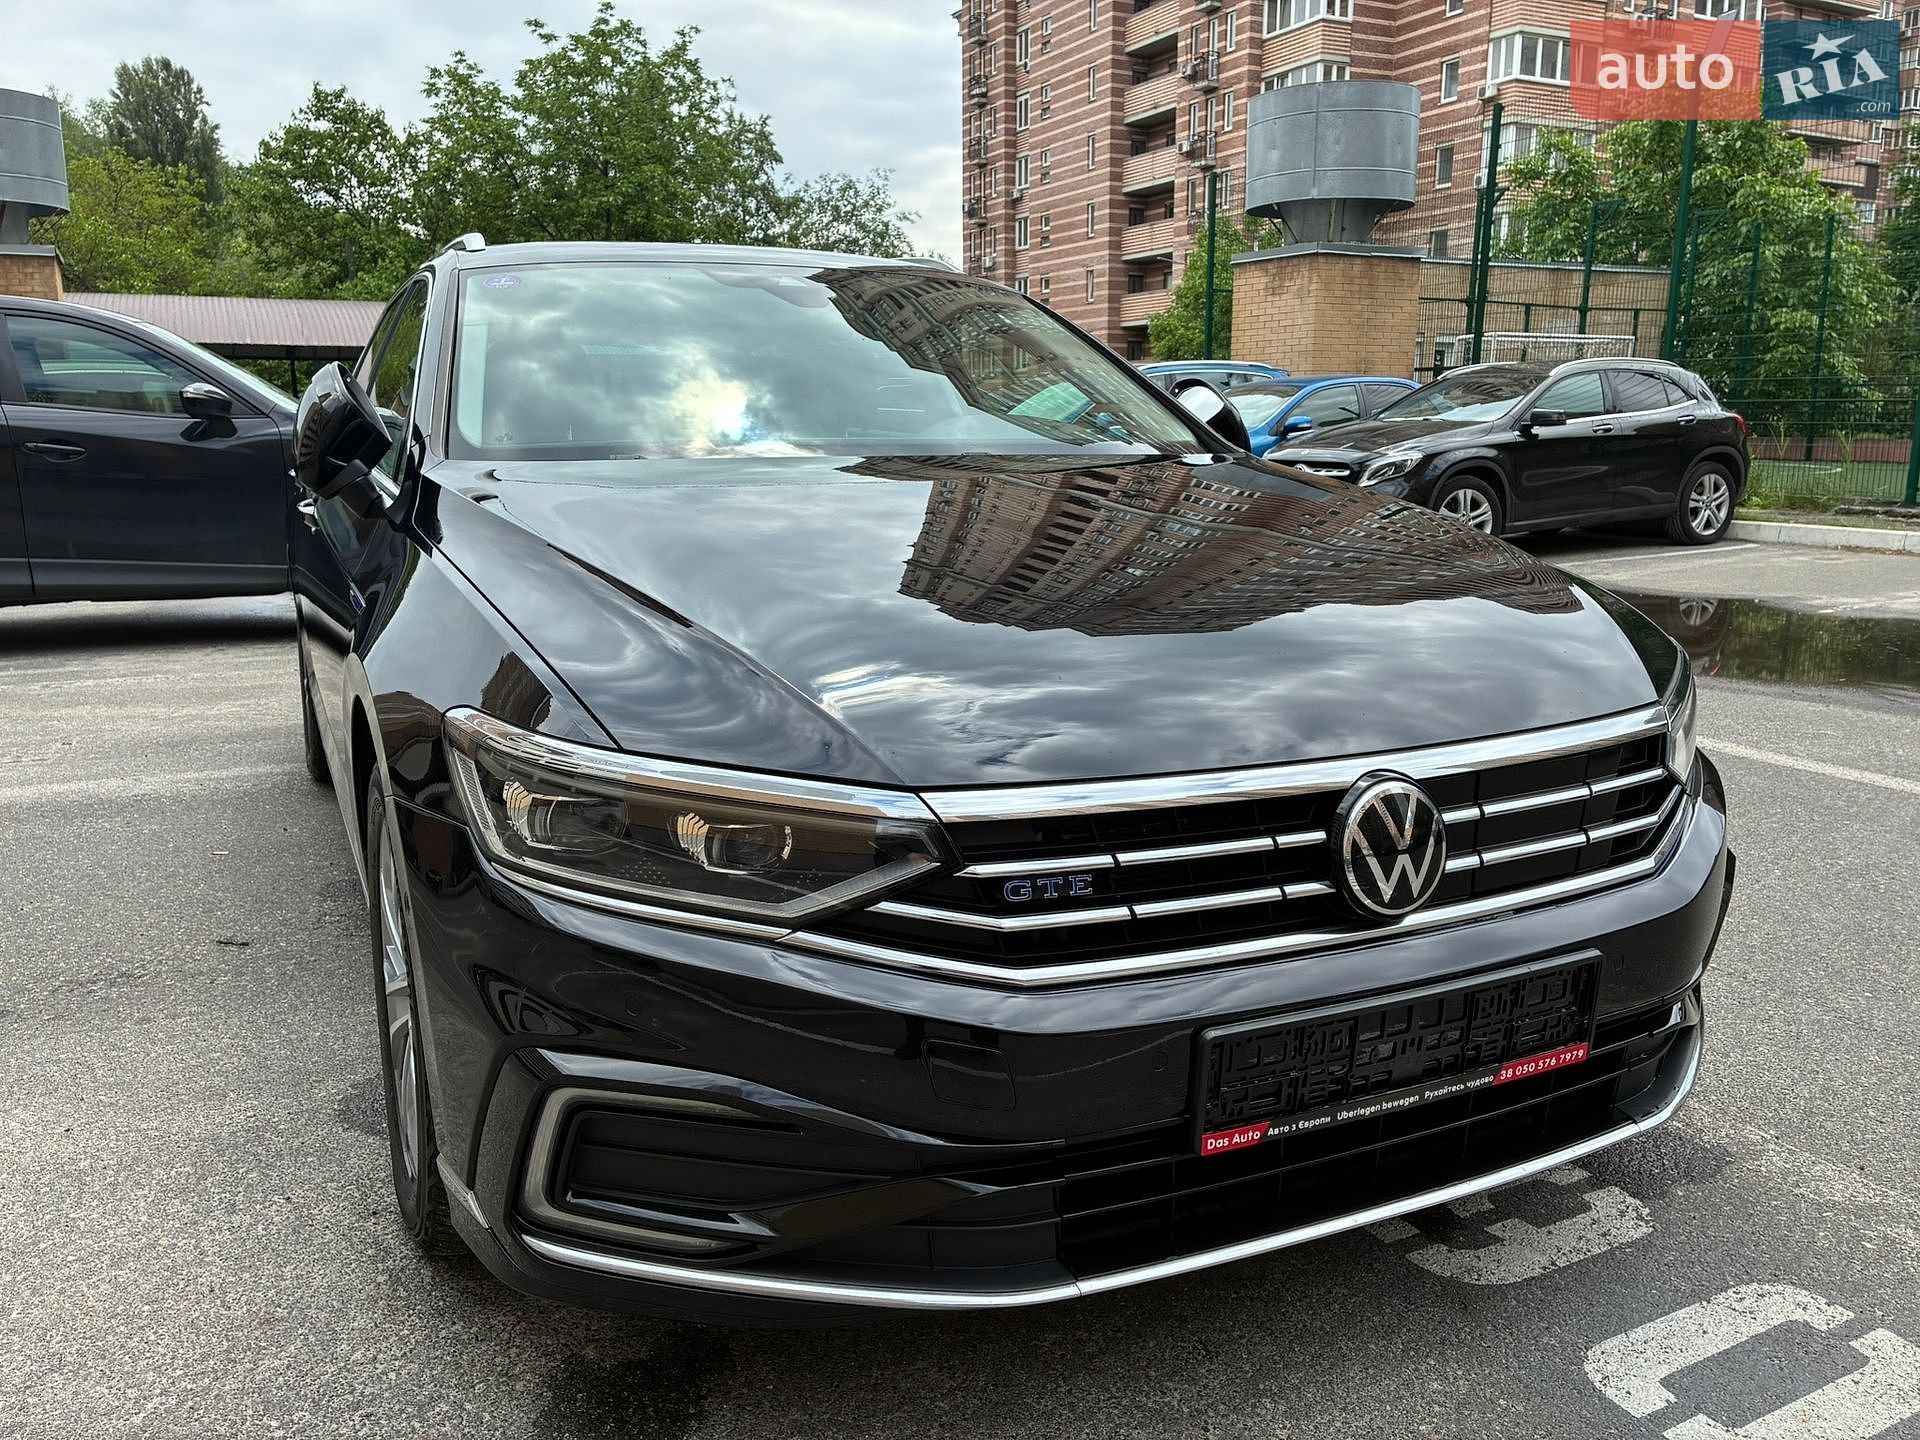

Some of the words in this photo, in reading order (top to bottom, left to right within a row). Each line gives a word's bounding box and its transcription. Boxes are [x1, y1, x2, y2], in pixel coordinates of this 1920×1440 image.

[1003, 874, 1094, 902] GTE
[1500, 1068, 1513, 1080] 38
[1516, 1062, 1535, 1076] 050
[1537, 1056, 1556, 1070] 576
[1559, 1049, 1584, 1064] 7979
[1424, 1083, 1465, 1099] Рухайтесь
[1466, 1075, 1494, 1089] чудово
[1382, 1095, 1420, 1110] bewegen
[1267, 1125, 1290, 1137] Авто
[1298, 1115, 1332, 1129] Європи
[1207, 1137, 1229, 1150] Das
[1232, 1130, 1260, 1144] Auto
